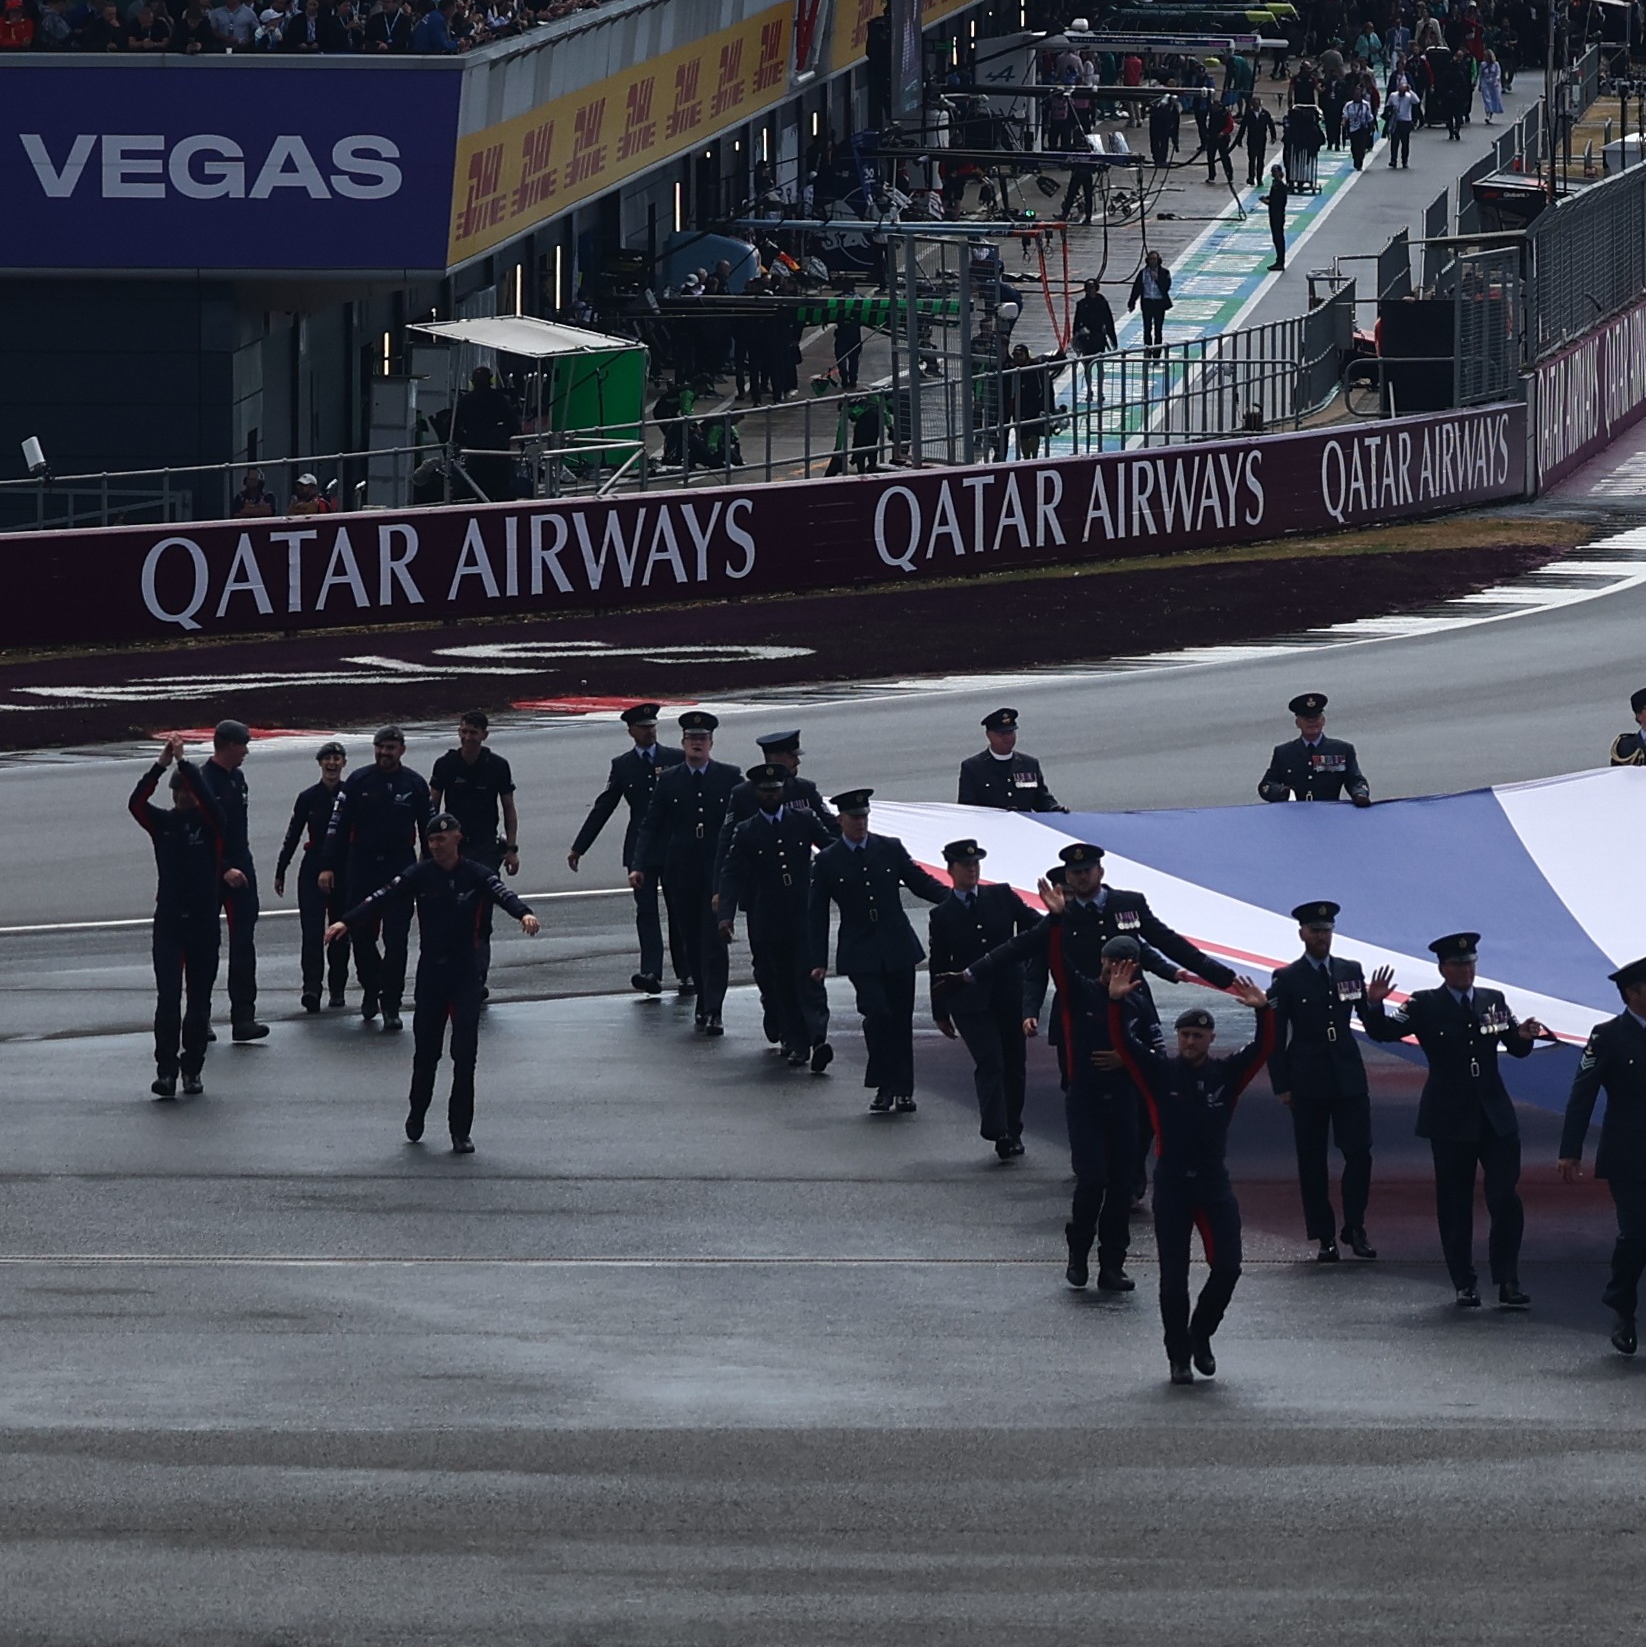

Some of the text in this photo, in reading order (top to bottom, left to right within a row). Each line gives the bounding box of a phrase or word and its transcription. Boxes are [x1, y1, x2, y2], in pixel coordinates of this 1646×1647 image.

[19, 134, 404, 200] VEGAS
[874, 449, 1265, 572] QATAR AIRWAYS
[1321, 432, 1413, 524] QATAR
[1419, 413, 1509, 501] AIRWAYS
[140, 498, 756, 630] QATAR AIRWAYS
